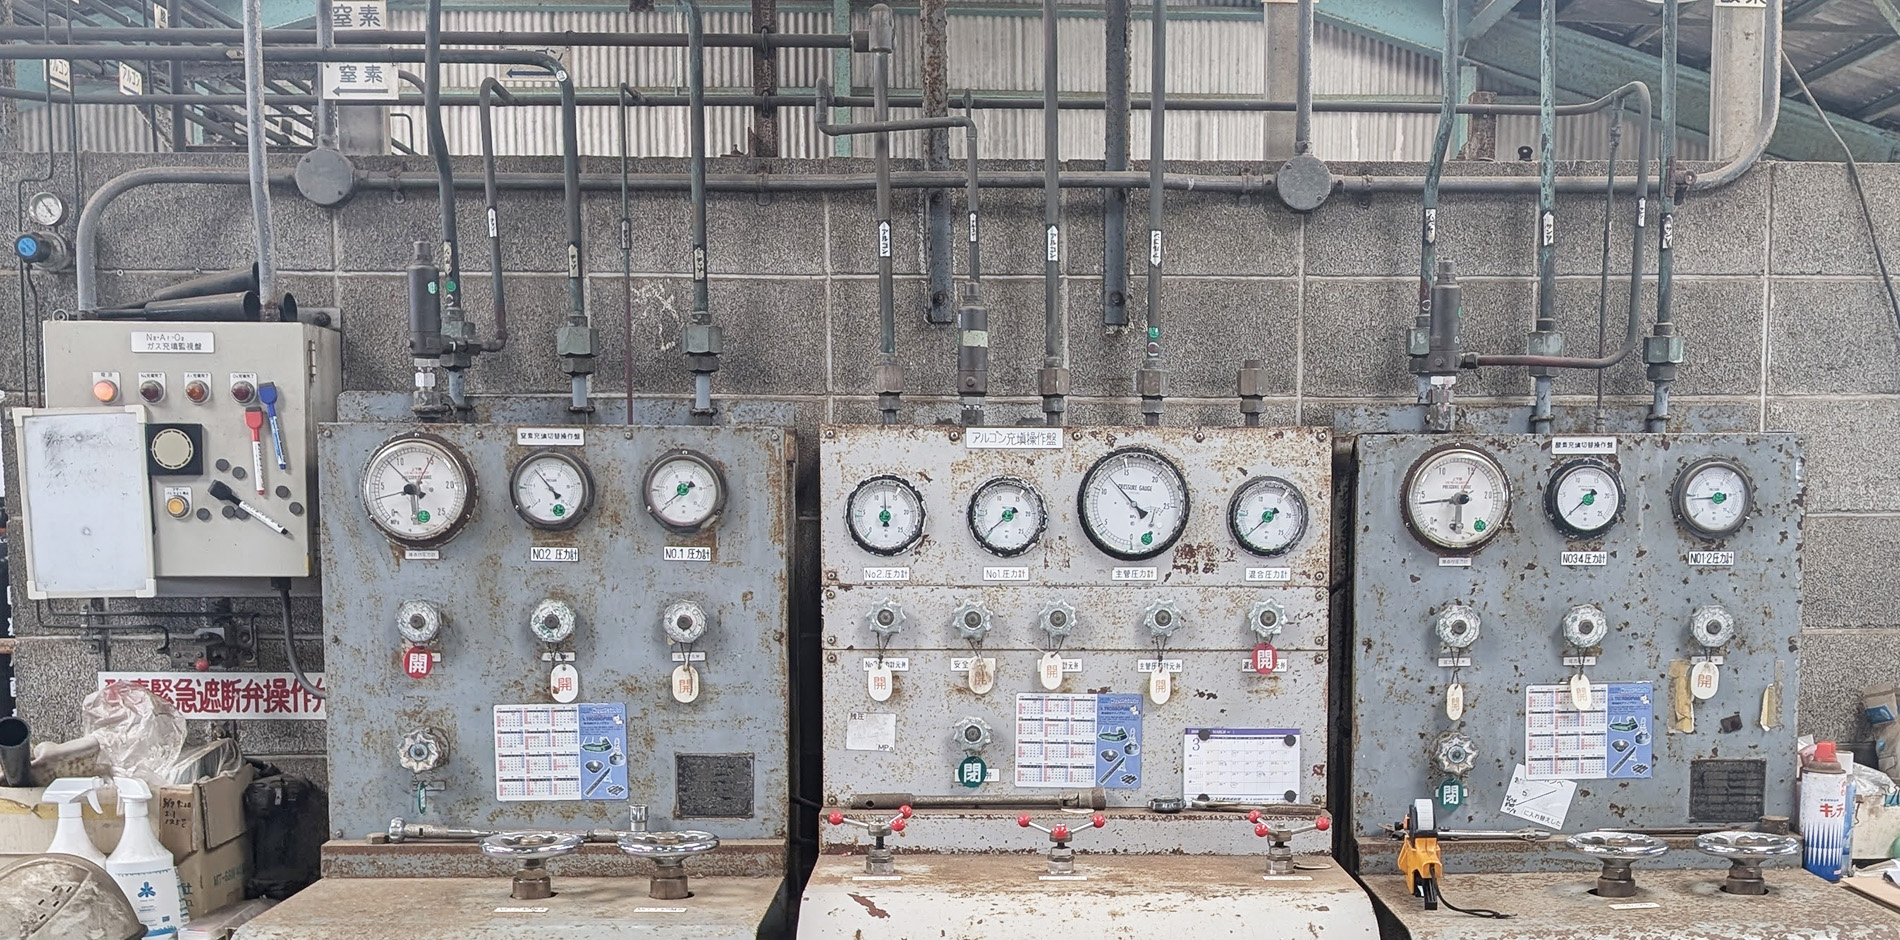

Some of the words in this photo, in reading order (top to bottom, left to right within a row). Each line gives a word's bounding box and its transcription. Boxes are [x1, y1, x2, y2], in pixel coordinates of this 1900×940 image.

[333, 4, 381, 27] 窒素
[339, 64, 383, 84] 窒素
[1151, 475, 1159, 483] 20
[686, 548, 710, 560] 圧力計
[1115, 570, 1155, 579] 主管圧力計
[1248, 570, 1288, 579] 混合圧力計
[409, 653, 428, 674] 開
[1257, 649, 1273, 669] 開
[1046, 664, 1058, 678] 開
[557, 676, 573, 692] 開
[678, 678, 692, 694] 開
[874, 676, 886, 691] 開
[1155, 679, 1167, 693] 開
[1698, 673, 1712, 689] 開
[104, 678, 326, 713] 緊急遮断弁操作
[1576, 686, 1588, 702] 開
[964, 762, 982, 783] 閉
[1443, 784, 1459, 805] 閉
[1521, 809, 1561, 827] に入れ替えした
